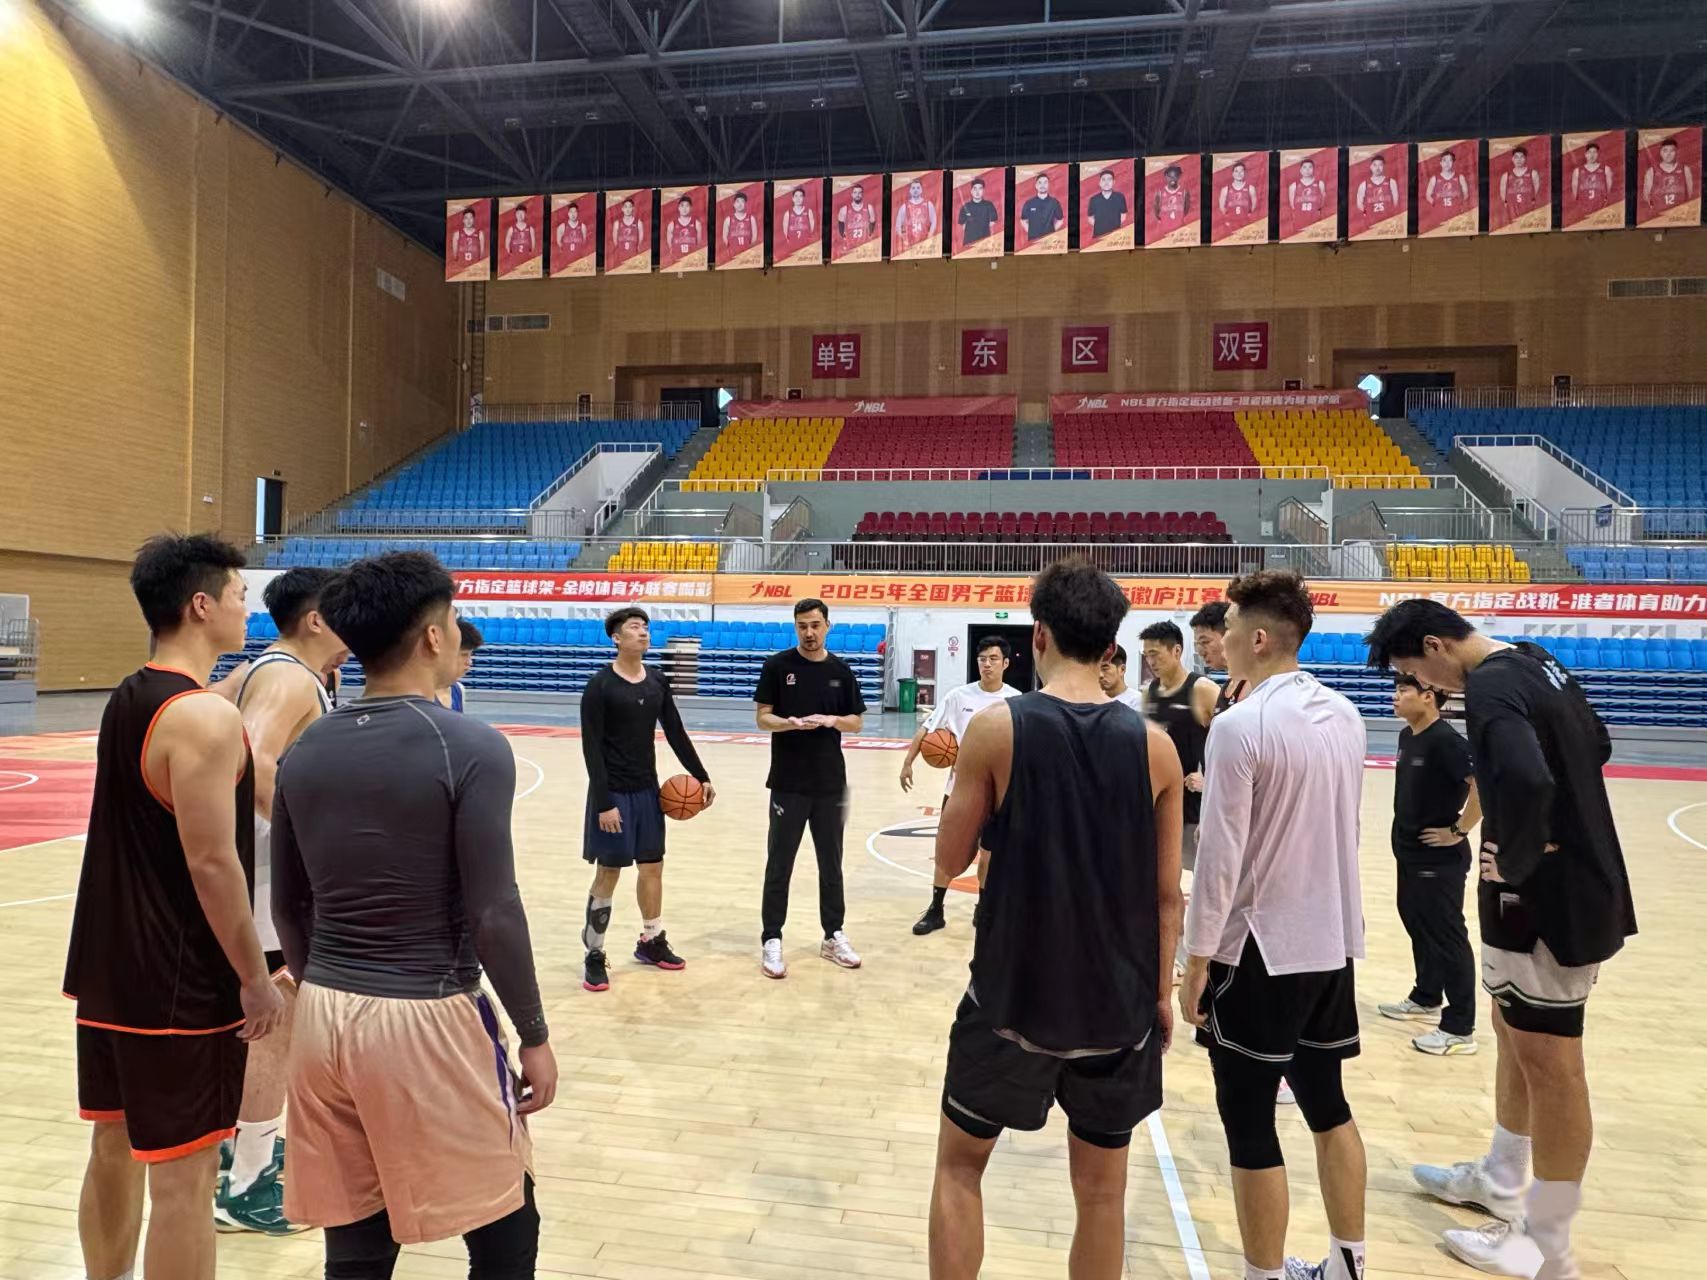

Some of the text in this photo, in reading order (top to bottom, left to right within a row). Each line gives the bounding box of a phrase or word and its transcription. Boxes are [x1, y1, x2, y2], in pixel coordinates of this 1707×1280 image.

[1442, 197, 1452, 207] 15
[1516, 194, 1522, 203] 5
[1664, 194, 1675, 205] 12
[1373, 202, 1384, 212] 25
[852, 229, 863, 238] 23
[1072, 336, 1098, 365] 区
[1218, 331, 1263, 362] 双号
[816, 341, 857, 371] 单号
[971, 337, 998, 368] 东
[863, 402, 887, 413] NBL
[1086, 399, 1109, 409] NBL
[763, 585, 794, 598] NBL
[1121, 586, 1230, 605] 徽庐江赛
